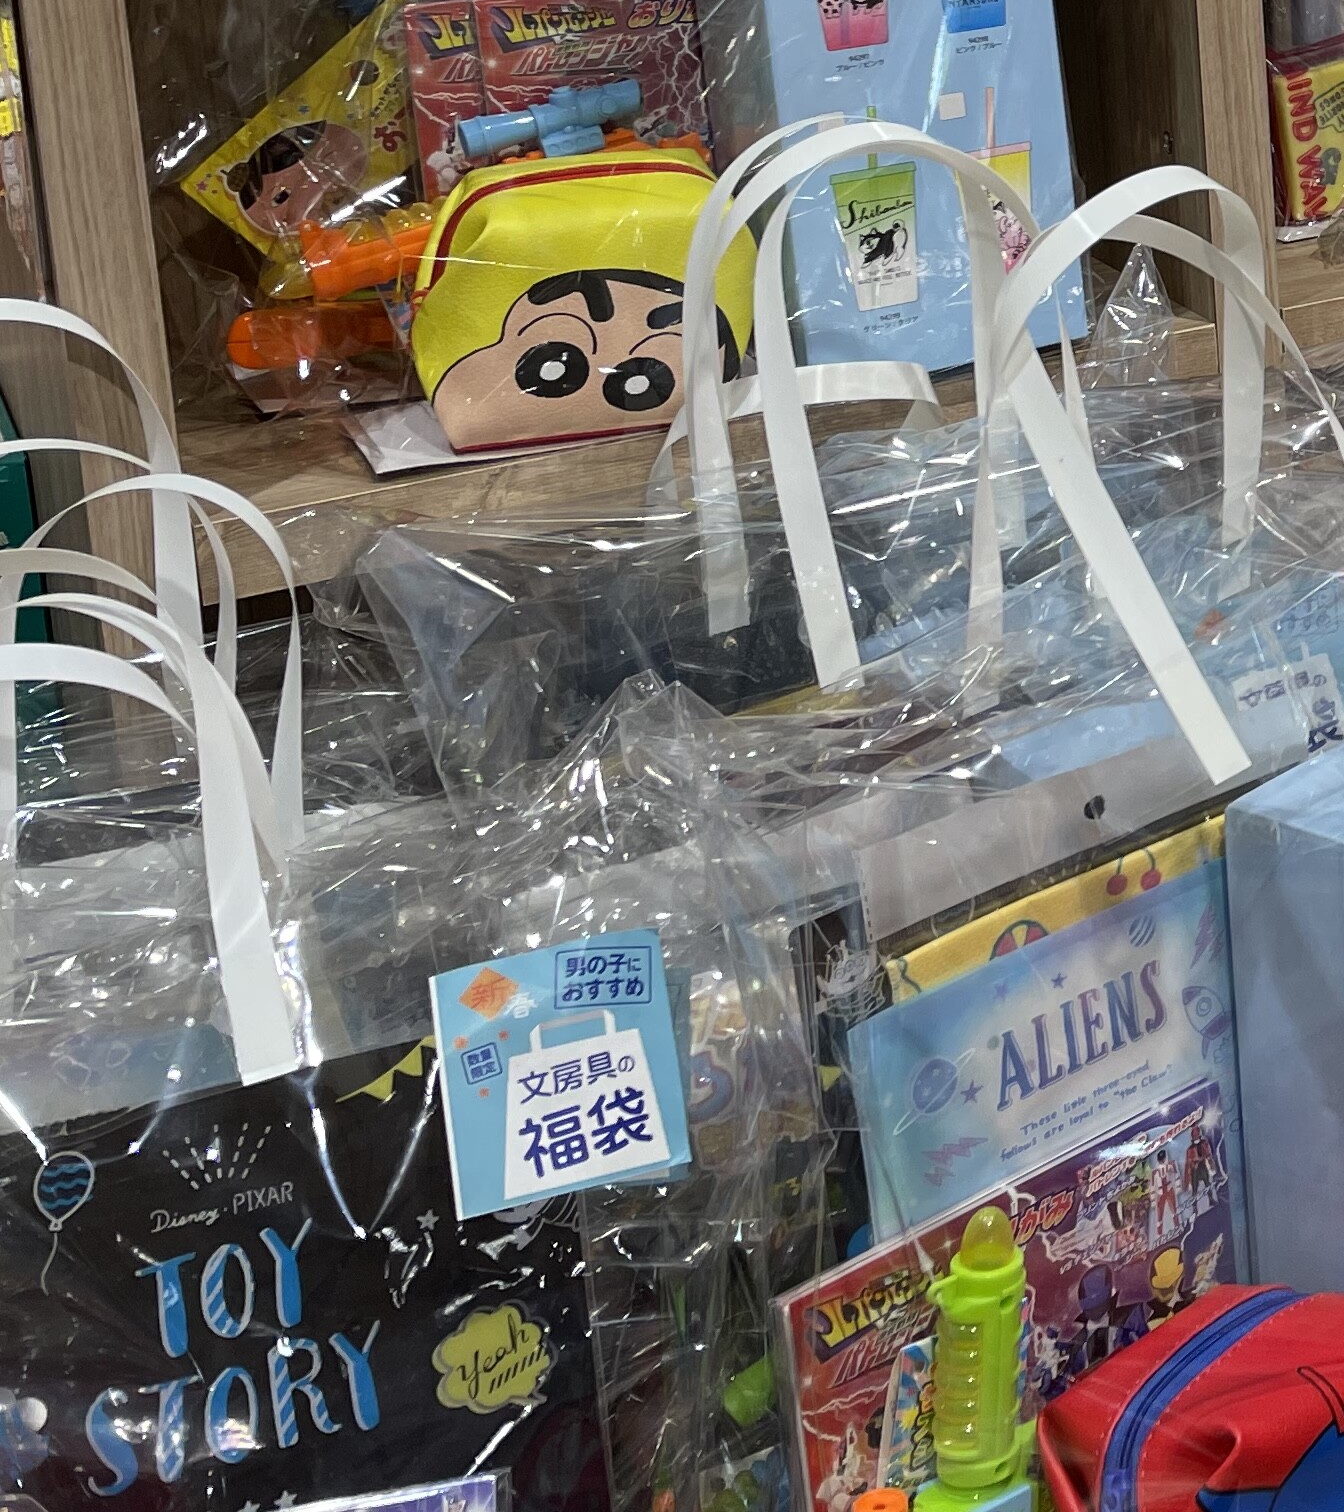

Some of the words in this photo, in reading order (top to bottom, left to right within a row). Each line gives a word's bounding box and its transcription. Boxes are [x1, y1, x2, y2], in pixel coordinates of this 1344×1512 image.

[562, 977, 645, 1002] おすすめ
[565, 953, 642, 978] 男の子に
[997, 959, 1168, 1113] ALIENS
[517, 1051, 636, 1105] 文房具の
[519, 1086, 653, 1178] 福袋
[1000, 1136, 1041, 1163] fellows
[1043, 1124, 1067, 1141] are
[1069, 1107, 1096, 1129] loyal
[1020, 1112, 1058, 1137] These
[150, 1207, 220, 1234] Disney
[232, 1181, 294, 1215] PIXAR
[135, 1217, 313, 1359] TOY
[85, 1319, 381, 1497] STORY
